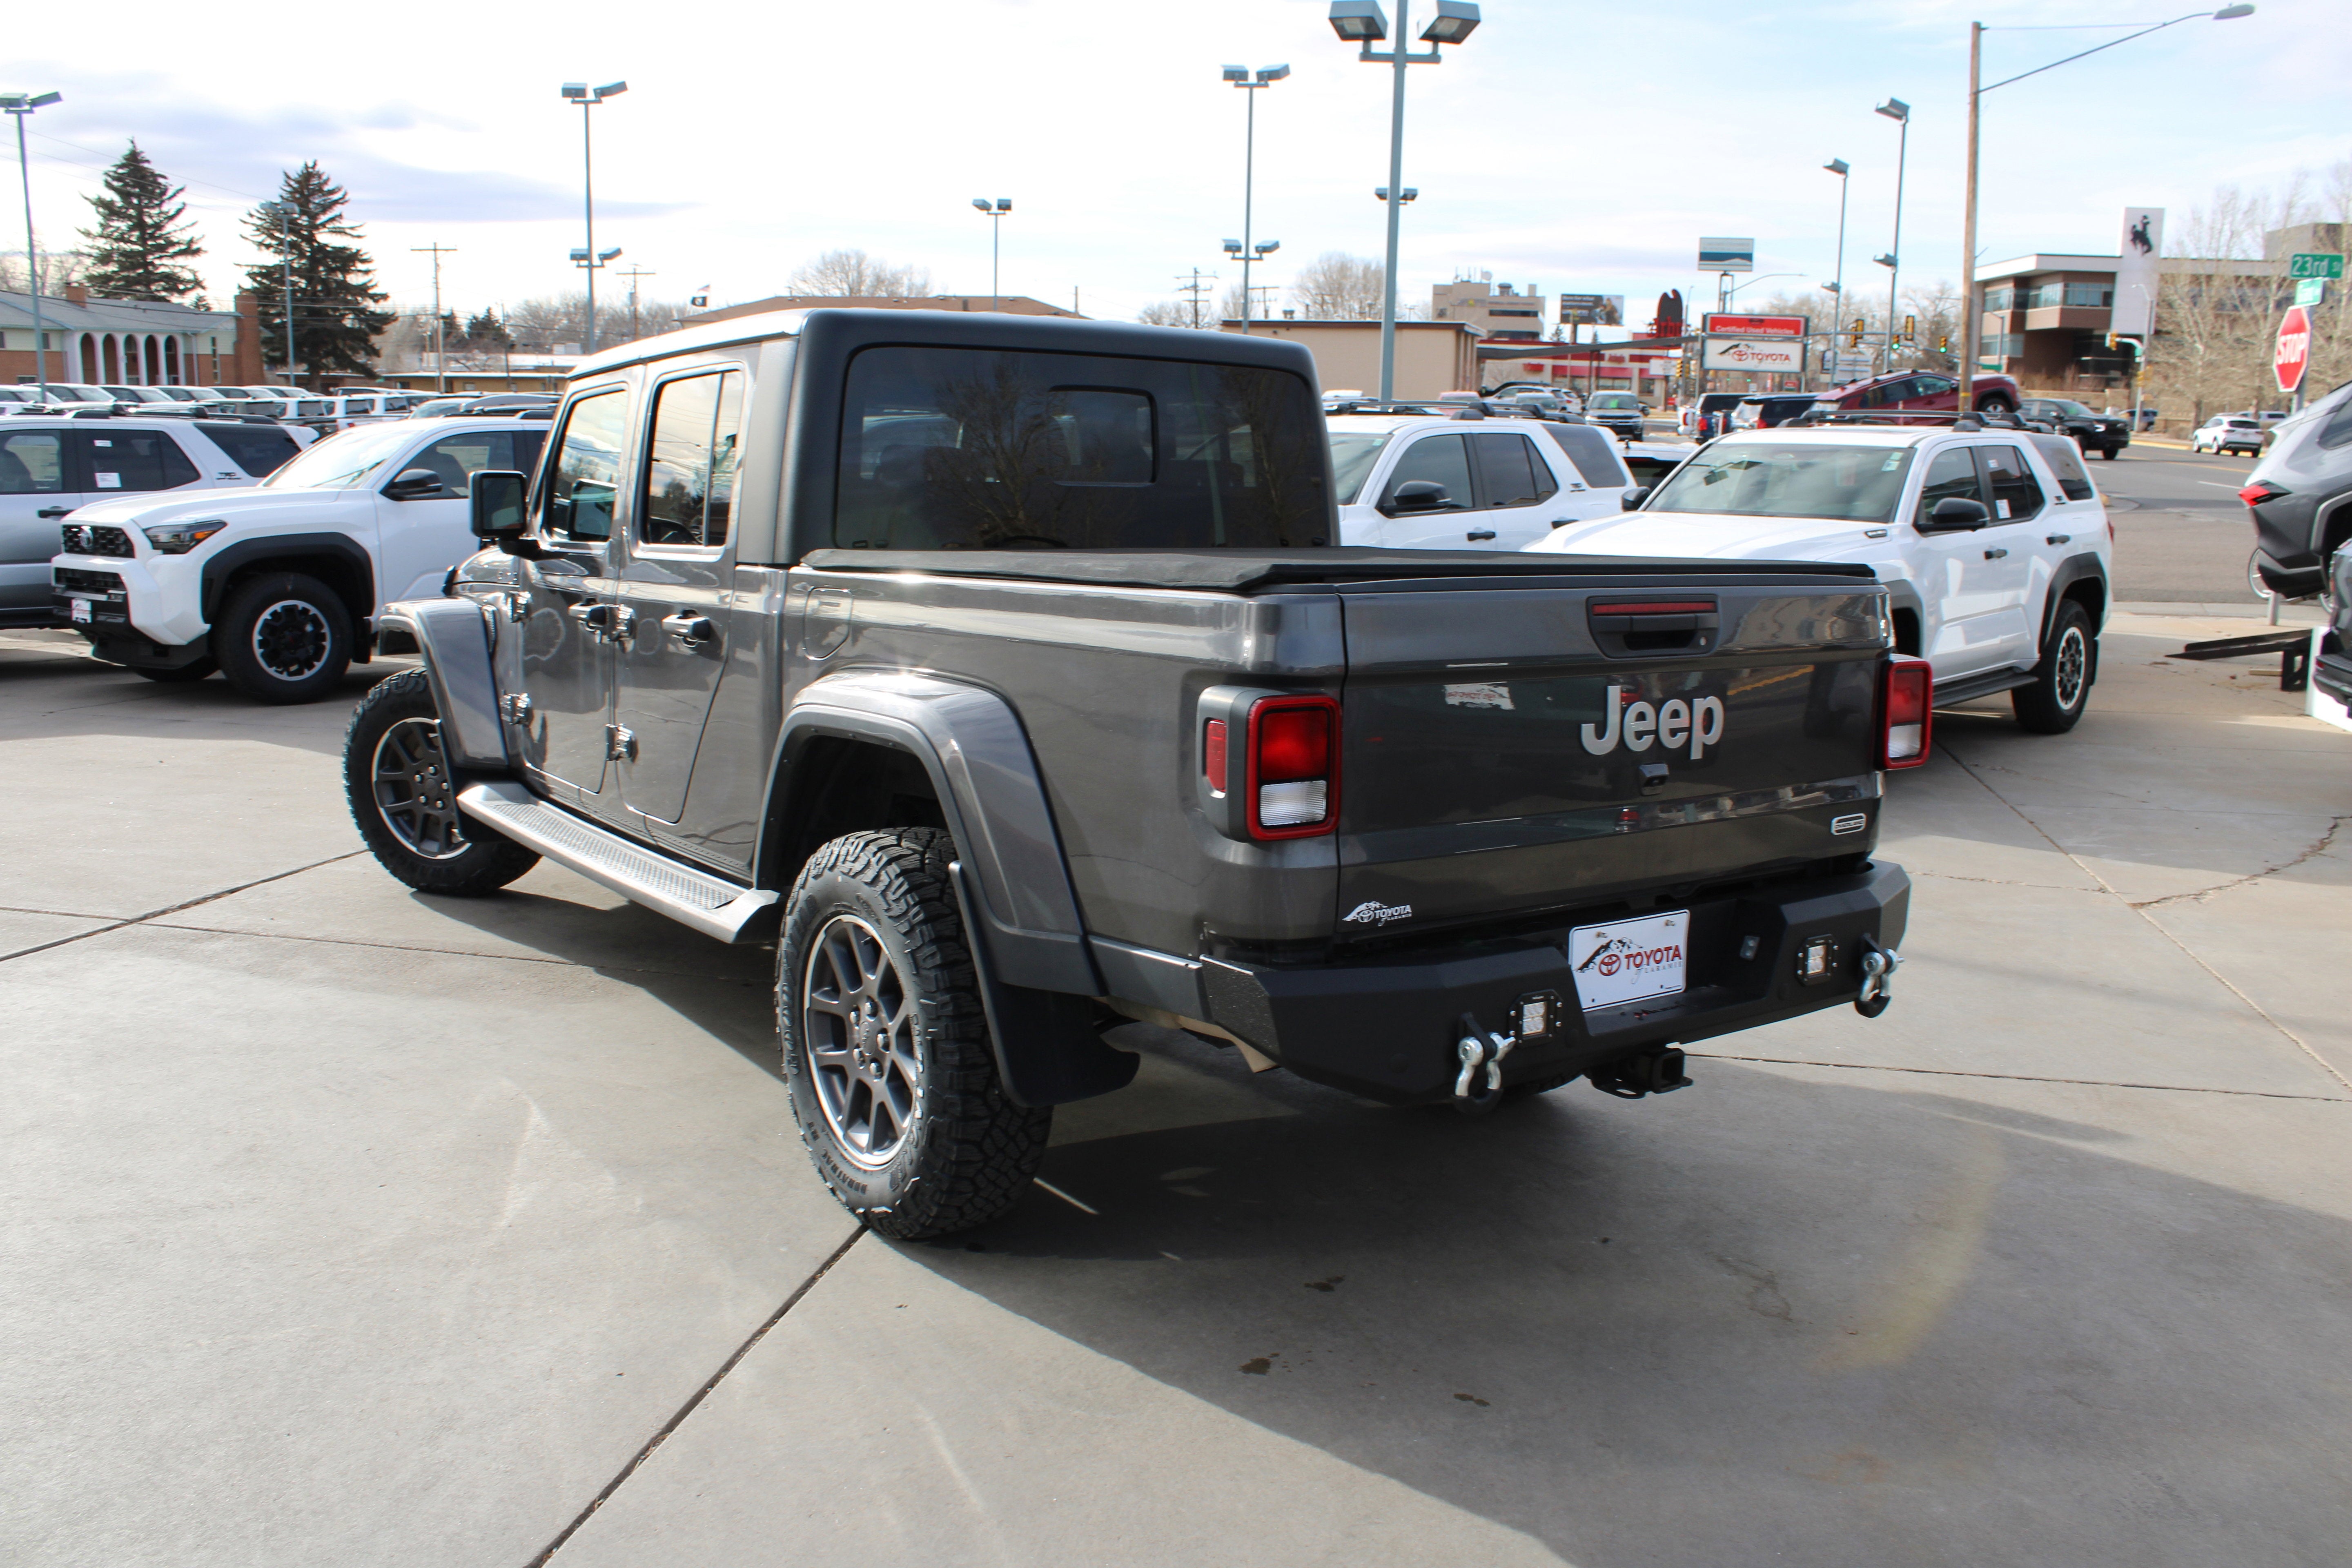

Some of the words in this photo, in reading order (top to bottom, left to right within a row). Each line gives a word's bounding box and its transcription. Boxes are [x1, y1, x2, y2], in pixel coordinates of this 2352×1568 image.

[2292, 256, 2330, 276] 23rd
[1750, 352, 1791, 362] TOYOTA
[2277, 333, 2306, 365] STOP
[1581, 685, 1724, 760] Jeep
[1374, 905, 1412, 918] TOYOTA
[1624, 944, 1682, 970] TOYOTA
[1644, 961, 1683, 973] LARAMIE
